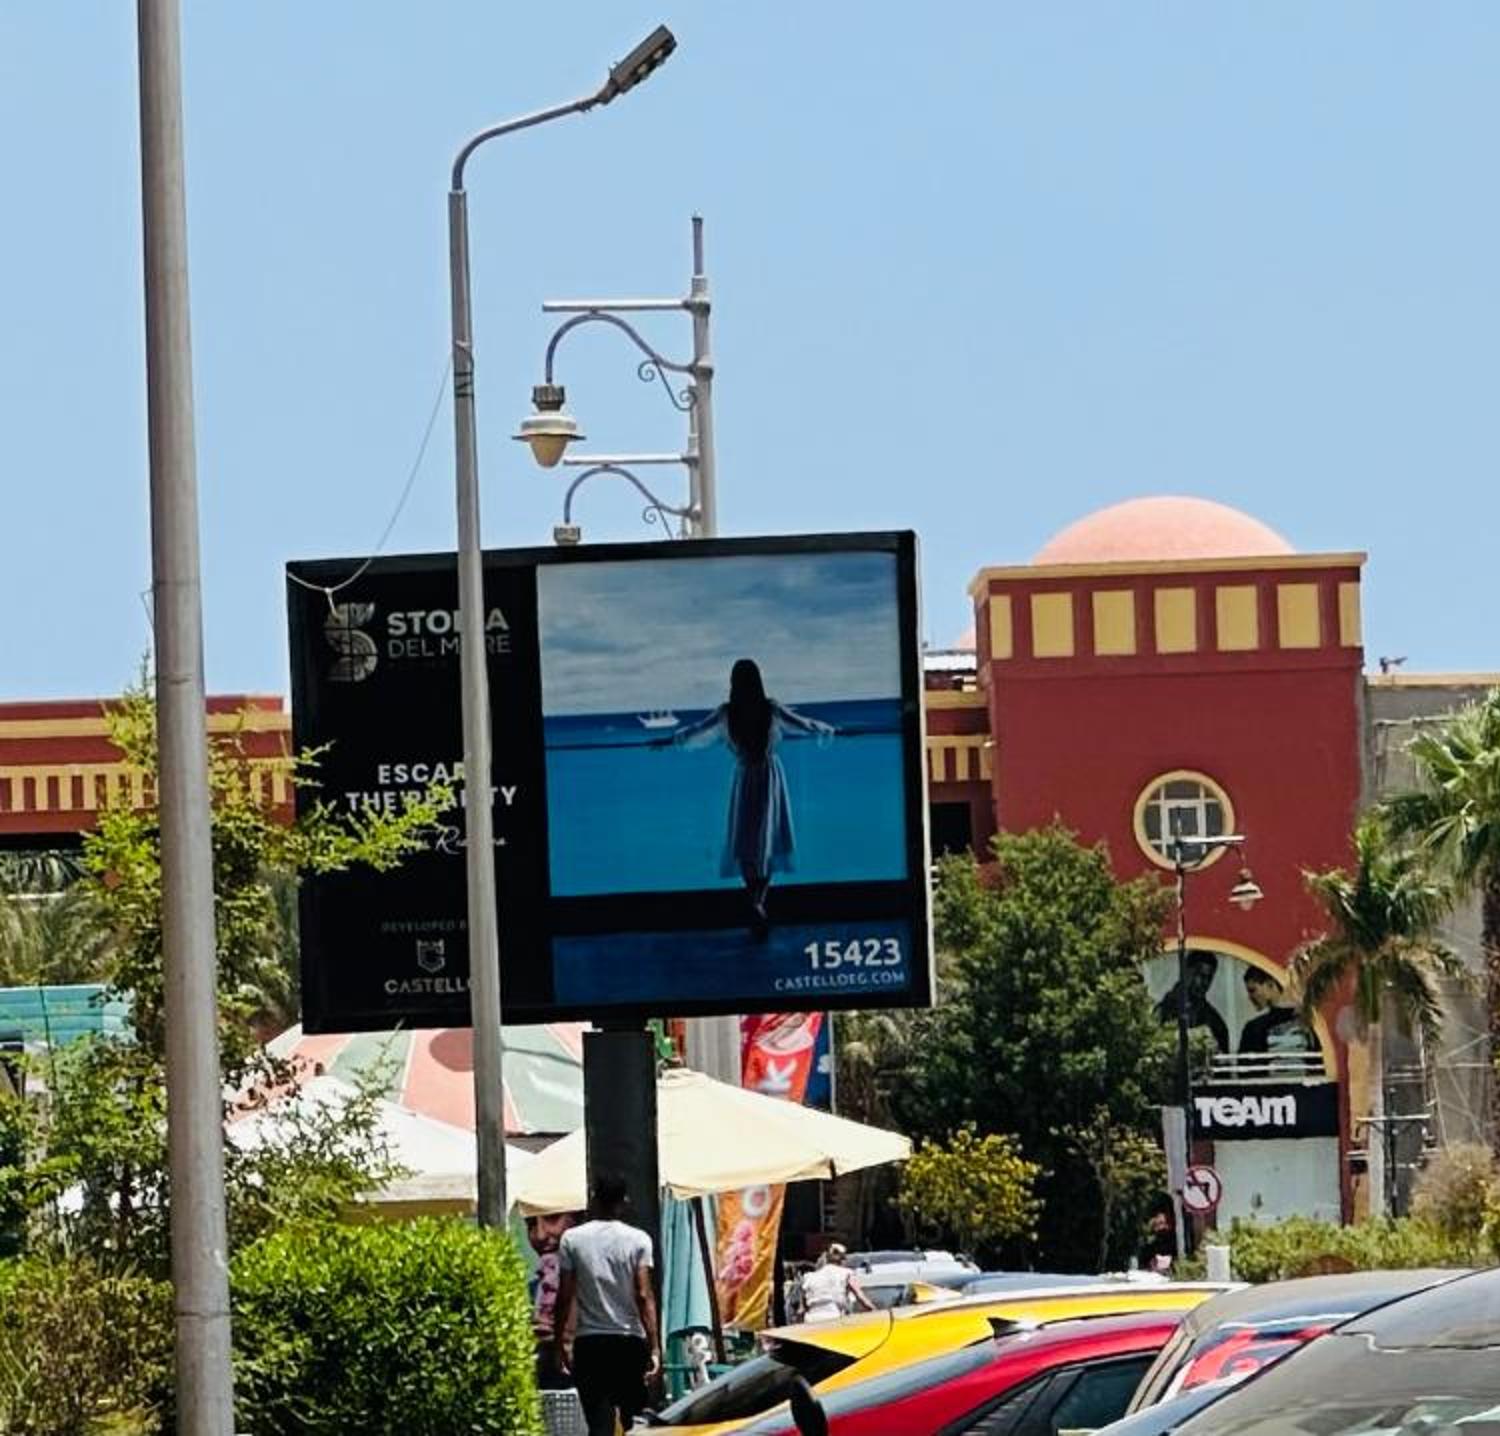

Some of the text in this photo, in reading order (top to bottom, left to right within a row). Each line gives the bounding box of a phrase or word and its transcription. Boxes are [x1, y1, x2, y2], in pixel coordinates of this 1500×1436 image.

[387, 608, 509, 636] STOA
[388, 638, 434, 658] DEL
[345, 791, 397, 812] THE
[804, 938, 902, 970] 15423
[774, 970, 905, 992] CASTELLOEG.COM
